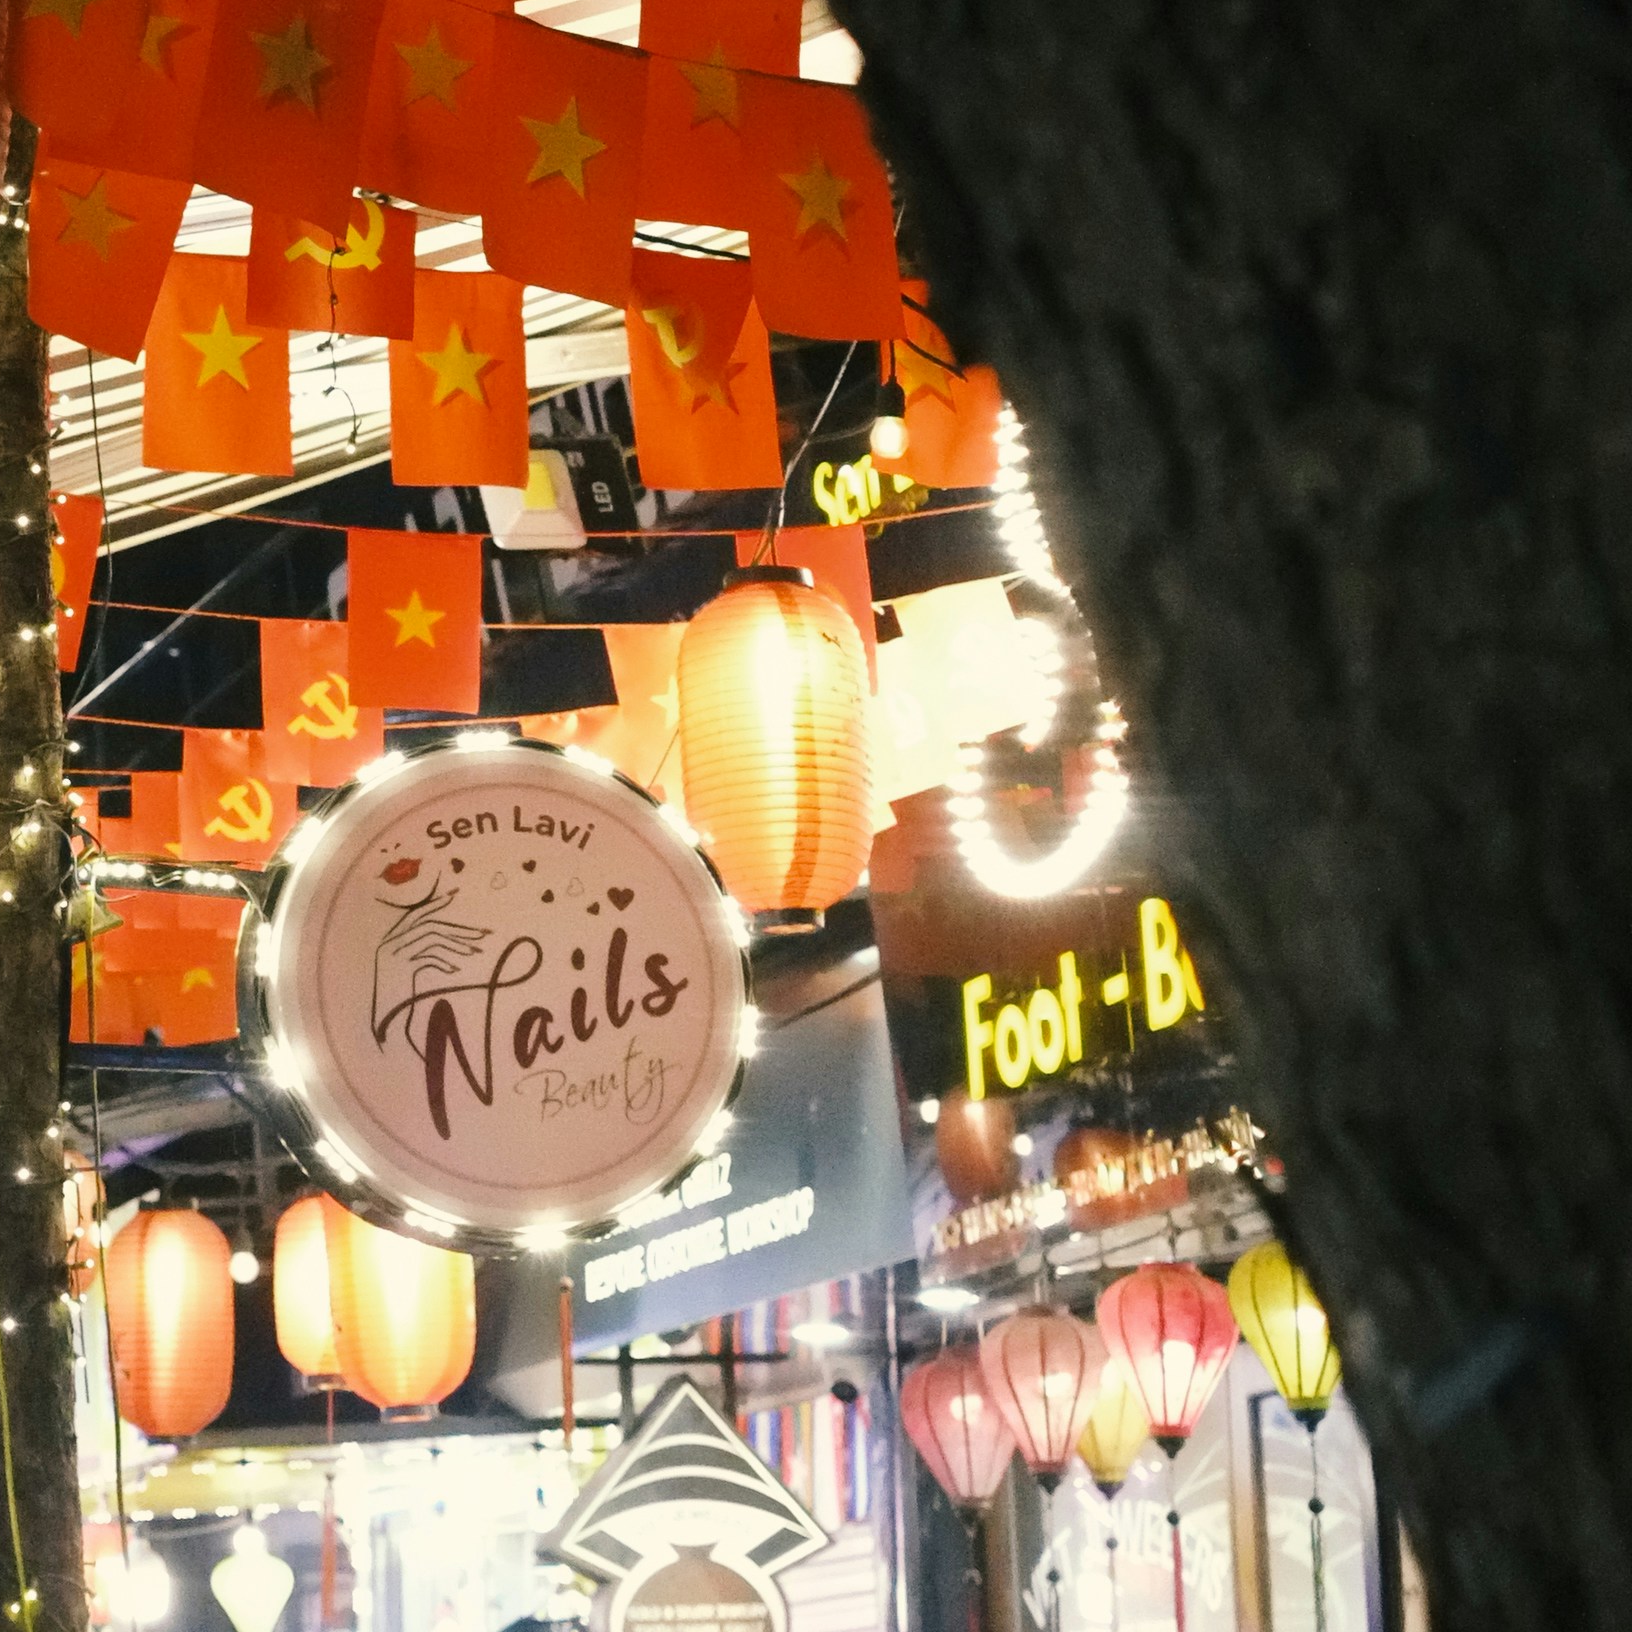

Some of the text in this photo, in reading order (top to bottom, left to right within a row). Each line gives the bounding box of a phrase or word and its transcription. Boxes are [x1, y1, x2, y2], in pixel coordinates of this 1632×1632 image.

[591, 480, 614, 513] LED
[426, 805, 595, 850] Sen Lavi
[375, 926, 689, 1140] Nails
[962, 950, 1084, 1101] Foot
[514, 1035, 678, 1125] Beauty
